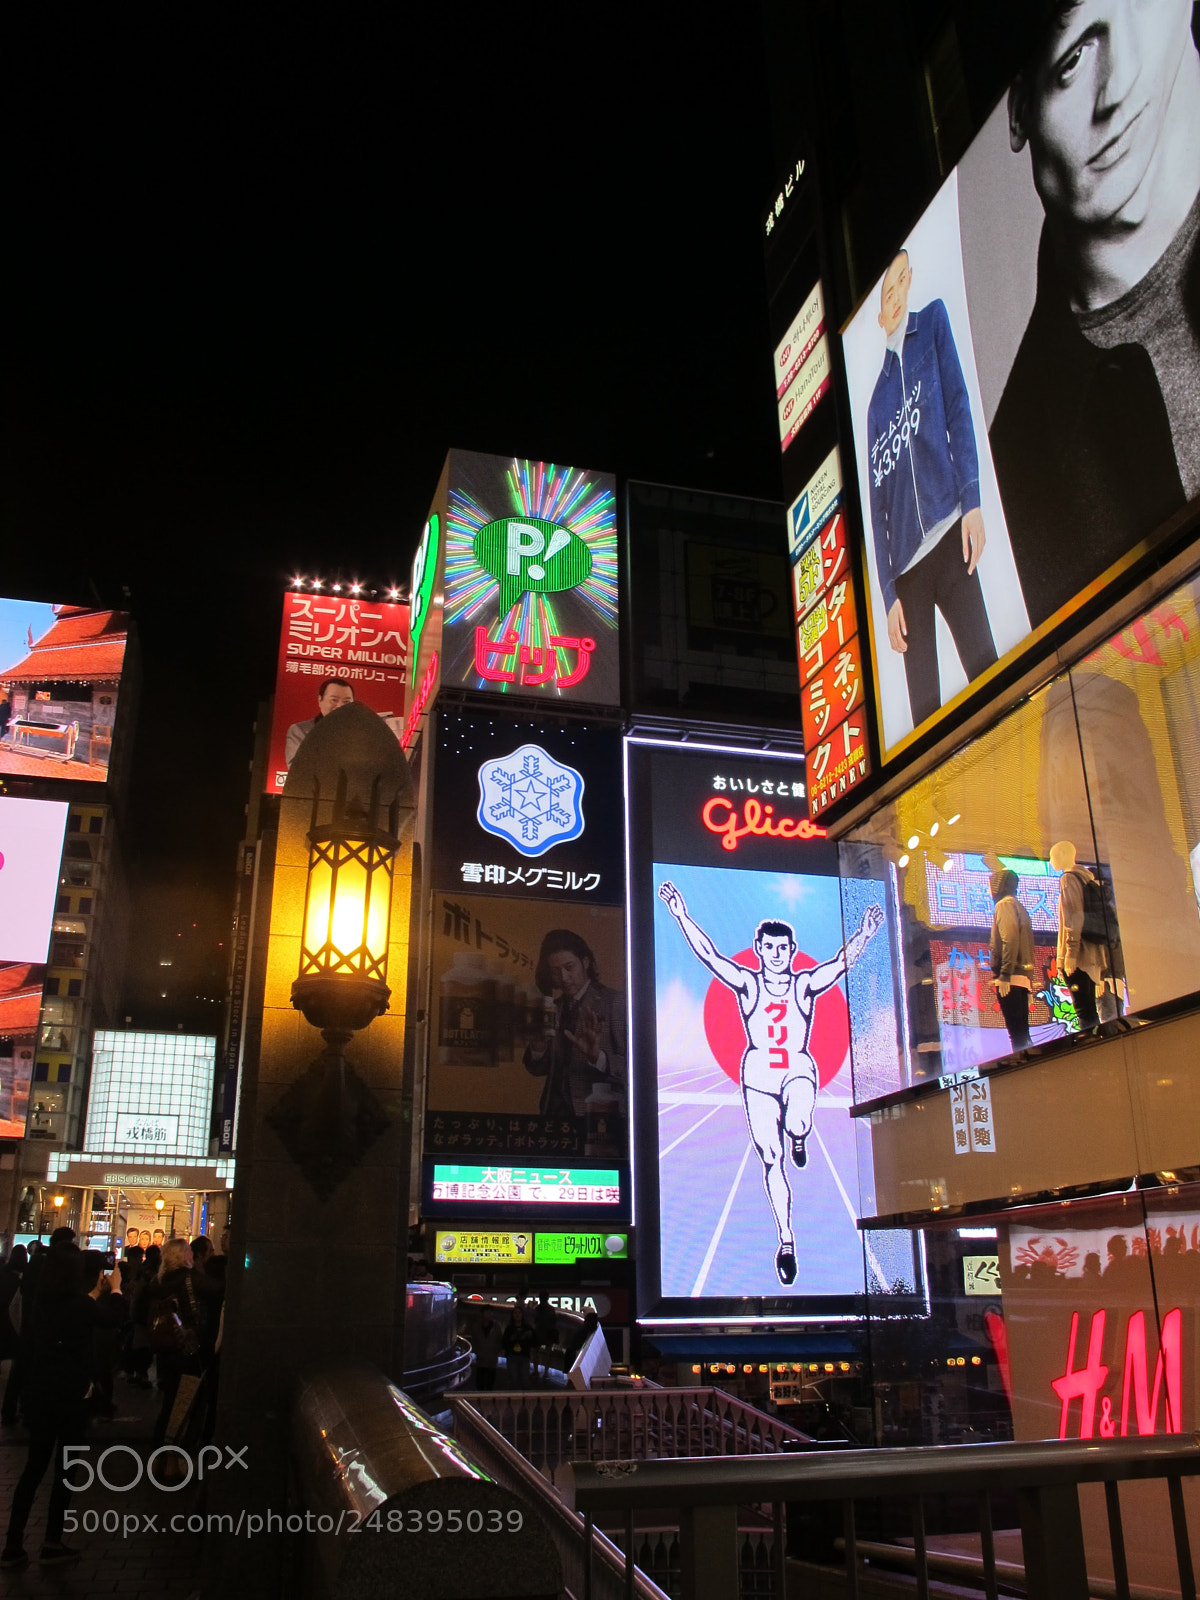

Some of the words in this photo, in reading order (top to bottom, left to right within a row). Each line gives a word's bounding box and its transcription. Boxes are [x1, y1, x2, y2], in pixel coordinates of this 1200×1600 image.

[871, 380, 921, 465] デニムシャツ
[873, 407, 920, 488] ¥3,999
[290, 598, 383, 624] スーパー
[822, 513, 860, 757] インターネット
[286, 643, 343, 660] SUPER
[347, 649, 407, 666] MILLION
[474, 625, 596, 689] ピップ
[804, 641, 831, 781] コミック
[712, 775, 806, 798] おいしさと健
[460, 862, 601, 891] 雪印メグミルク
[235, 974, 244, 995] Free
[232, 999, 240, 1024] Store
[231, 1028, 238, 1037] in
[764, 999, 789, 1069] グリコ
[228, 1041, 238, 1070] Japan
[126, 1126, 167, 1141] 戎橋筋
[481, 1167, 573, 1185] 大阪ニュース
[1051, 1307, 1182, 1440] H&M
